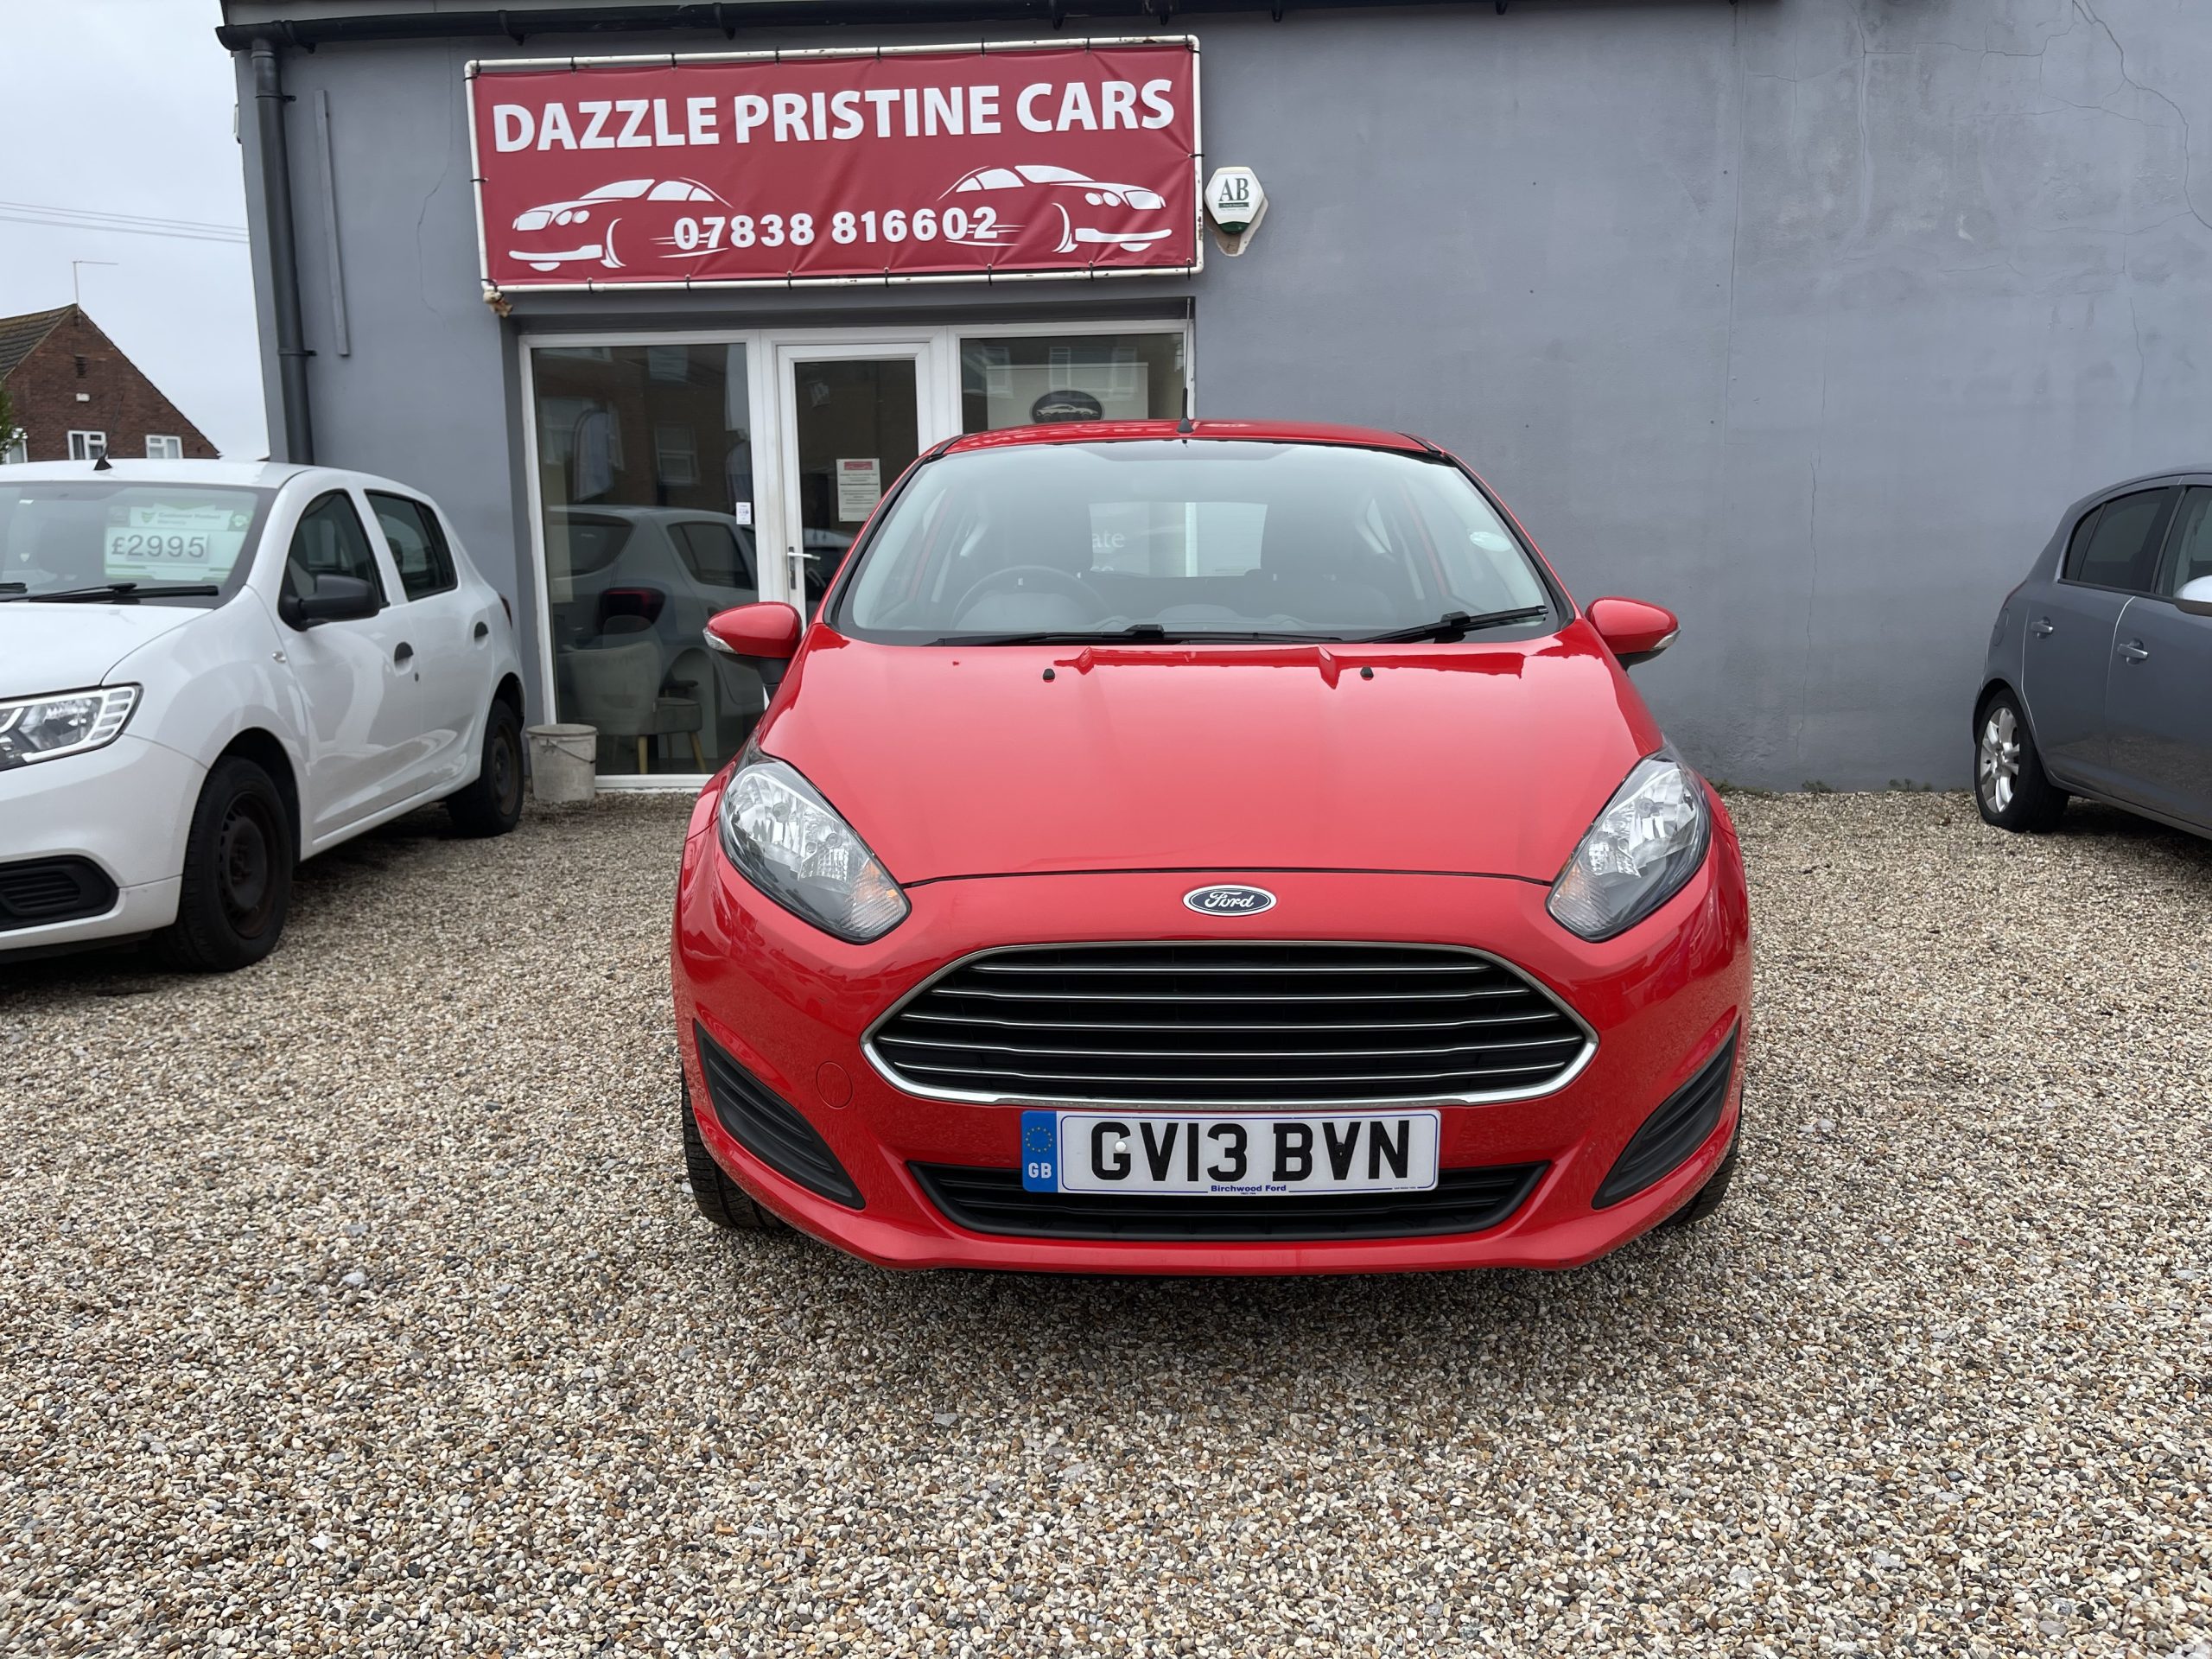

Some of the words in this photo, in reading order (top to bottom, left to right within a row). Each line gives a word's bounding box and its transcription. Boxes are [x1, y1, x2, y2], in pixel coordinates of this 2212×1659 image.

[493, 97, 720, 152] DAZZLE
[734, 86, 1001, 143] PRISTINE
[1016, 79, 1175, 133] CARS
[1218, 178, 1249, 201] AB
[673, 213, 815, 251] 07838
[831, 207, 998, 245] 816602
[111, 534, 205, 558] £2995
[1205, 891, 1255, 908] Ford
[1090, 1121, 1248, 1182] GV13
[1272, 1119, 1411, 1182] BVN
[1027, 1162, 1052, 1179] GB
